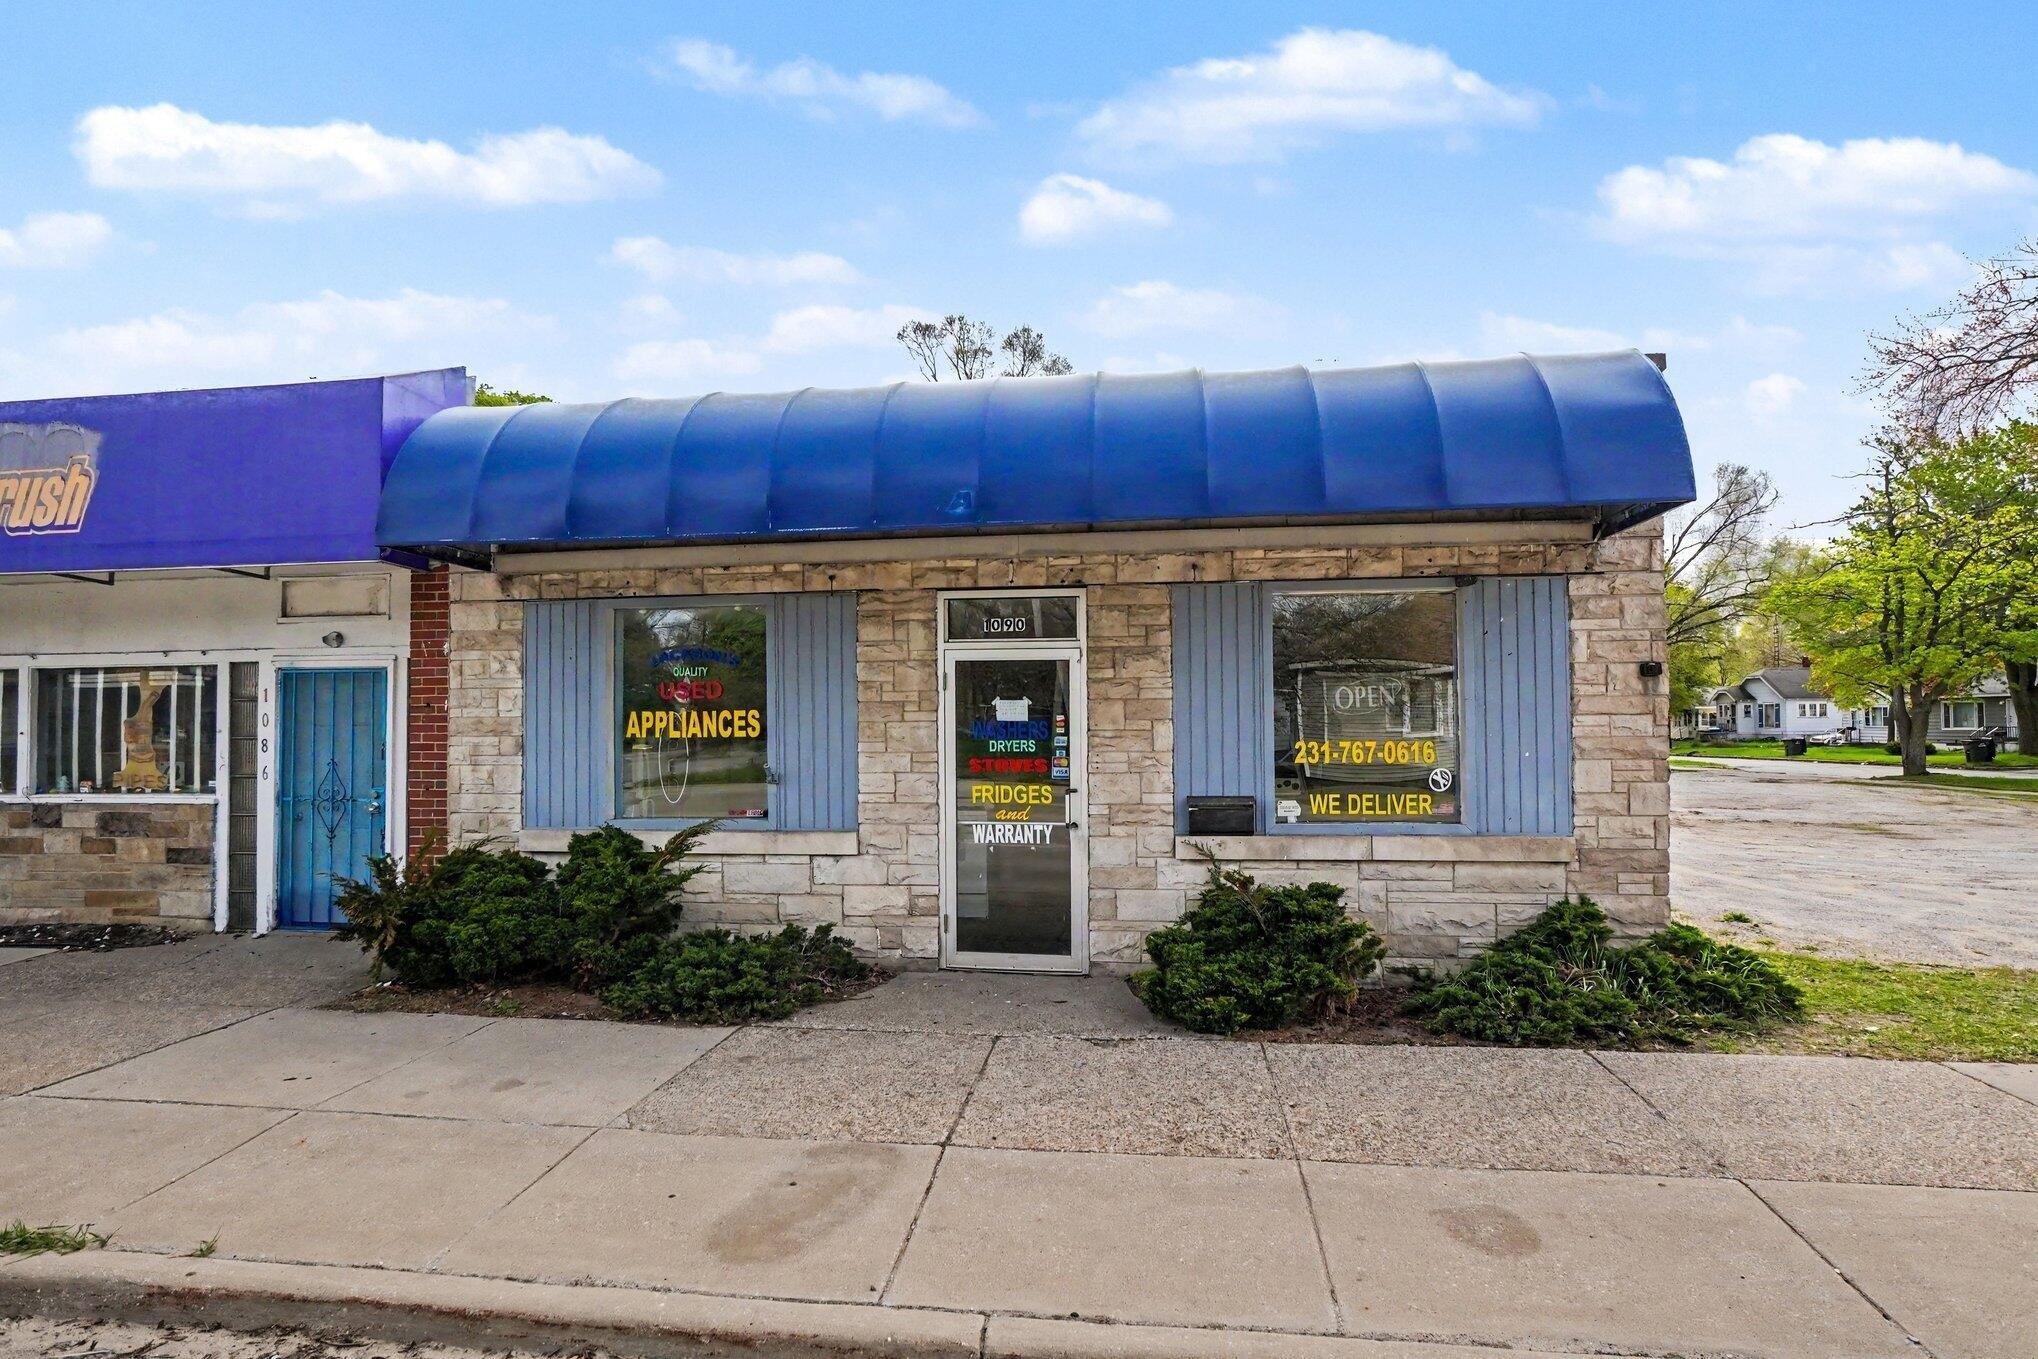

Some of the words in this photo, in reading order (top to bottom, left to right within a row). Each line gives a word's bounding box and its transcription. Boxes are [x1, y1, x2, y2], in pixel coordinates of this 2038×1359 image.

[984, 618, 1026, 632] 1090
[673, 666, 708, 677] QUALITY
[659, 680, 724, 700] USED
[1335, 682, 1397, 709] OPEN
[626, 709, 761, 739] APPLIANCES
[971, 719, 1049, 740] WASHERS
[989, 740, 1036, 753] DRYERS
[1294, 740, 1436, 765] 231-767-0616
[968, 757, 1048, 775] STOVES
[971, 784, 1053, 805] FRIDGES
[1310, 793, 1341, 816] WE
[1348, 793, 1433, 816] DELIVER
[995, 805, 1030, 821] and
[972, 824, 1053, 845] WARRANTY
